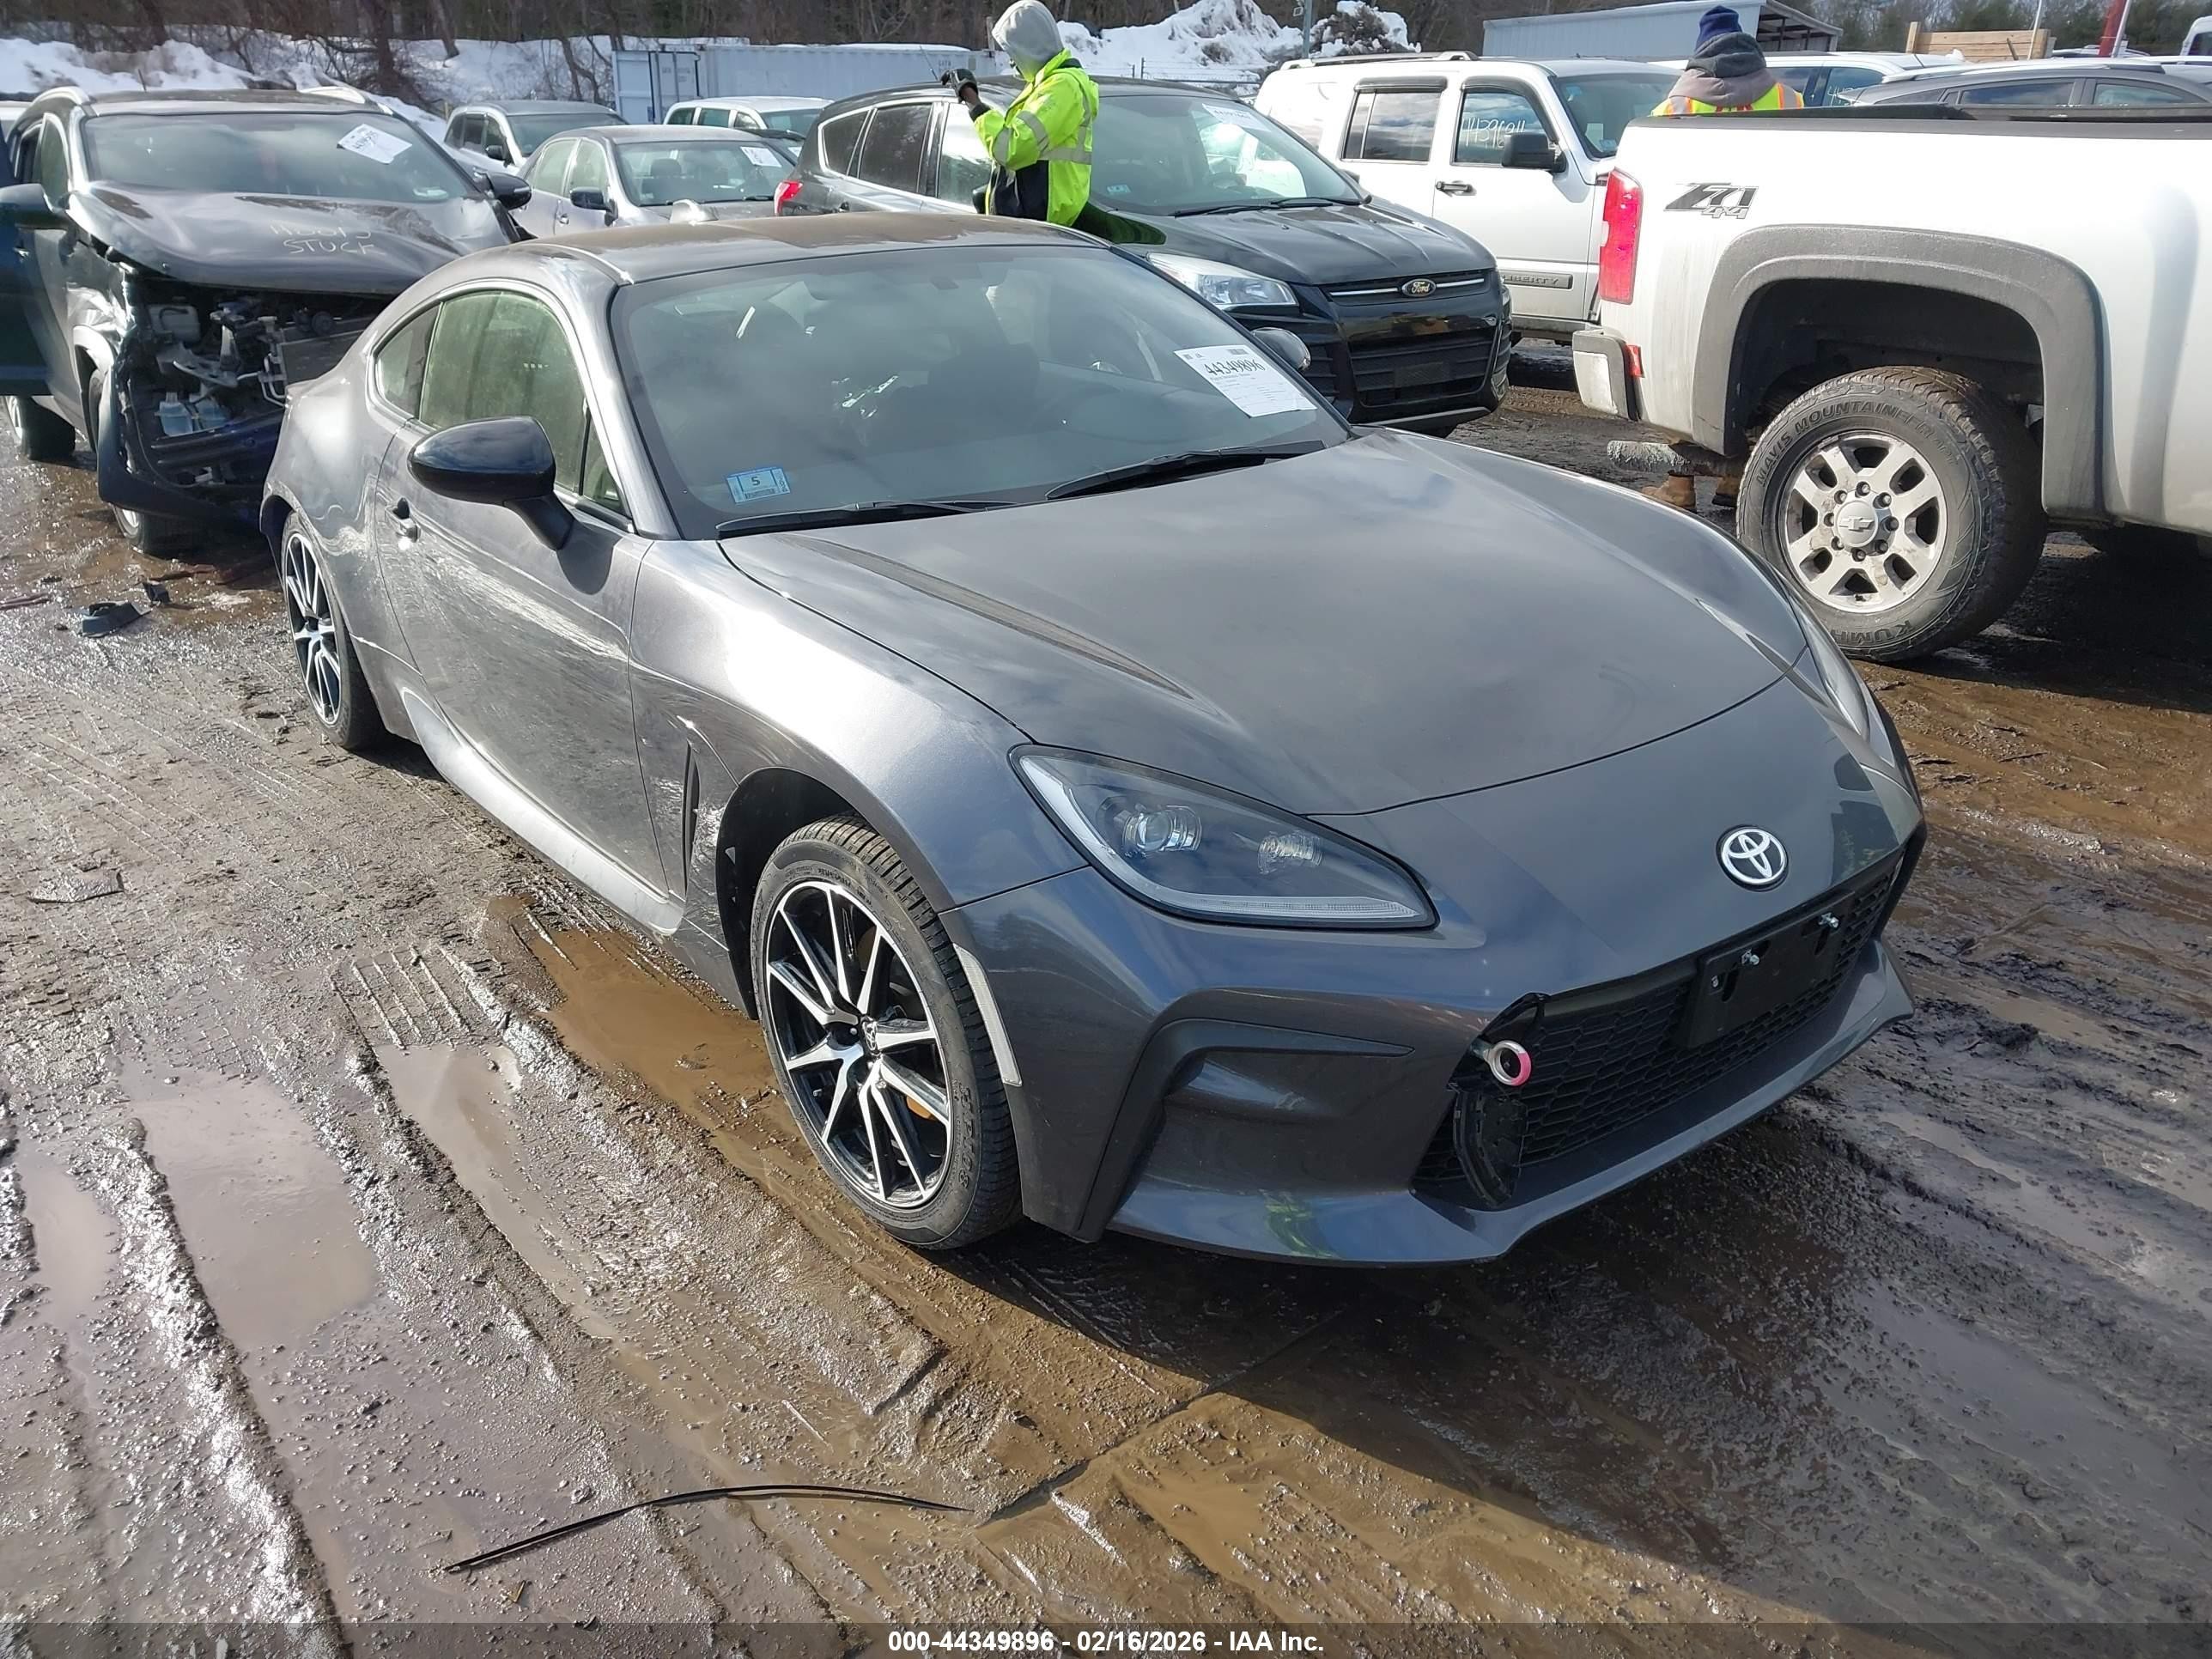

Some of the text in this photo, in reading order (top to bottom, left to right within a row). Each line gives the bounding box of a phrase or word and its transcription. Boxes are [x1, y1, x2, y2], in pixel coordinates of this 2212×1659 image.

[1663, 182, 1759, 211] Z71
[283, 239, 386, 255] STUCK
[1411, 281, 1431, 294] Ford
[1204, 358, 1266, 376] 44349896
[1757, 432, 1793, 487] MAVIS
[750, 476, 761, 486] 5
